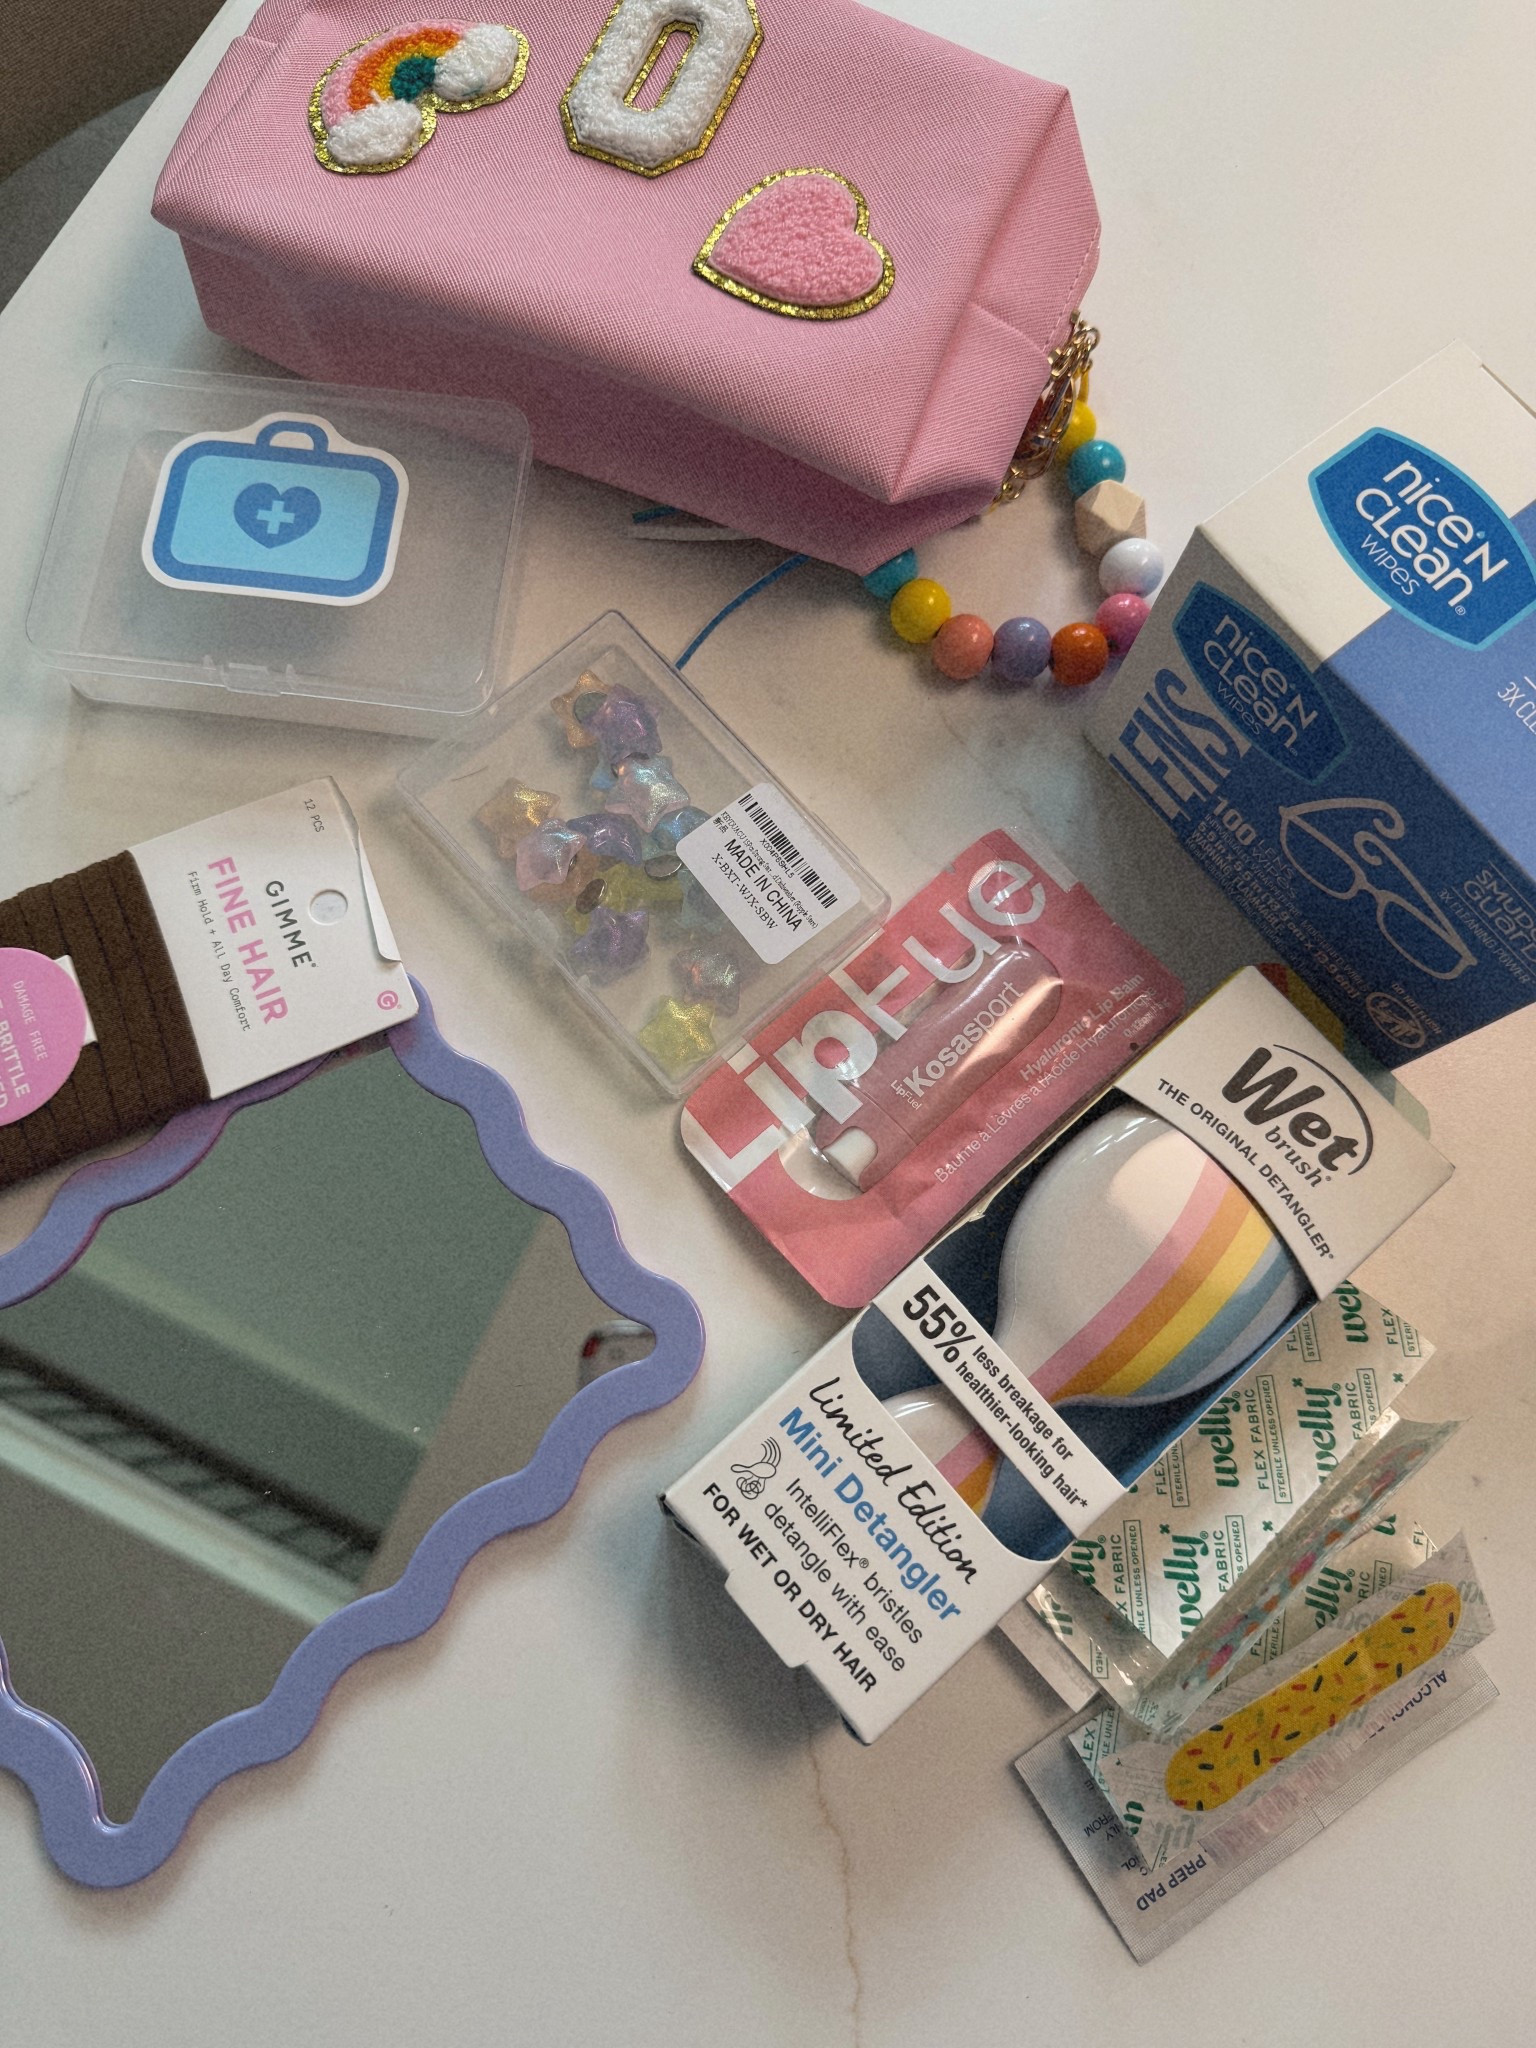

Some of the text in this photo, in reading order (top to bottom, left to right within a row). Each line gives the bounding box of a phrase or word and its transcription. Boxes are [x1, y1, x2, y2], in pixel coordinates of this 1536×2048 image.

[1497, 681, 1526, 708] 3X
[1108, 669, 1242, 823] LENS
[304, 798, 324, 833] 12 PCS
[1188, 829, 1235, 880] WARNING:
[1206, 796, 1260, 849] 100
[723, 838, 804, 931] MADE IN CHINA
[187, 870, 204, 896] Firm
[197, 899, 214, 924] Hold
[211, 939, 226, 959] All
[220, 963, 234, 984] Day
[228, 987, 252, 1031] Comfort
[207, 856, 290, 1024] FINE HAIR
[12, 980, 48, 1061] DAMAGE FREE
[1086, 995, 1116, 1021] Lip
[1110, 971, 1144, 1001] Balm
[0, 1020, 31, 1098] BRITTLE
[902, 980, 1024, 1098] Kosasport
[933, 1137, 983, 1183] Baume
[985, 1090, 1033, 1134] Lèvres
[1221, 1046, 1358, 1172] Wet
[1156, 1078, 1331, 1258] THE ORIGINAL DETANGLER
[1264, 1126, 1327, 1188] brush
[899, 1283, 975, 1364] 55%
[954, 1360, 1057, 1478] healthier-looking
[971, 1344, 1075, 1462] less breakage for
[1344, 1381, 1362, 1440] FABRIC
[1362, 1373, 1375, 1412] OPENED
[1244, 1388, 1268, 1490] FLEX FABRIC
[1261, 1379, 1286, 1497] STERILE UNLESS OPENED
[777, 1406, 962, 1621] Mini Detangler
[808, 1376, 980, 1585] Limited Edition
[1172, 1462, 1184, 1502] STERILE
[1109, 1533, 1125, 1593] FABRIC
[1128, 1524, 1139, 1564] OPENED
[1212, 1529, 1229, 1592] FABRIC
[1231, 1520, 1242, 1562] OPENED
[701, 1482, 879, 1693] FOR WET OR DRY HAIR
[761, 1499, 908, 1674] detangle with ease
[862, 1571, 927, 1645] bristles
[1132, 1566, 1143, 1606] UNLESS
[1134, 1882, 1167, 1912] PAD
[1165, 1853, 1207, 1888] PREP
